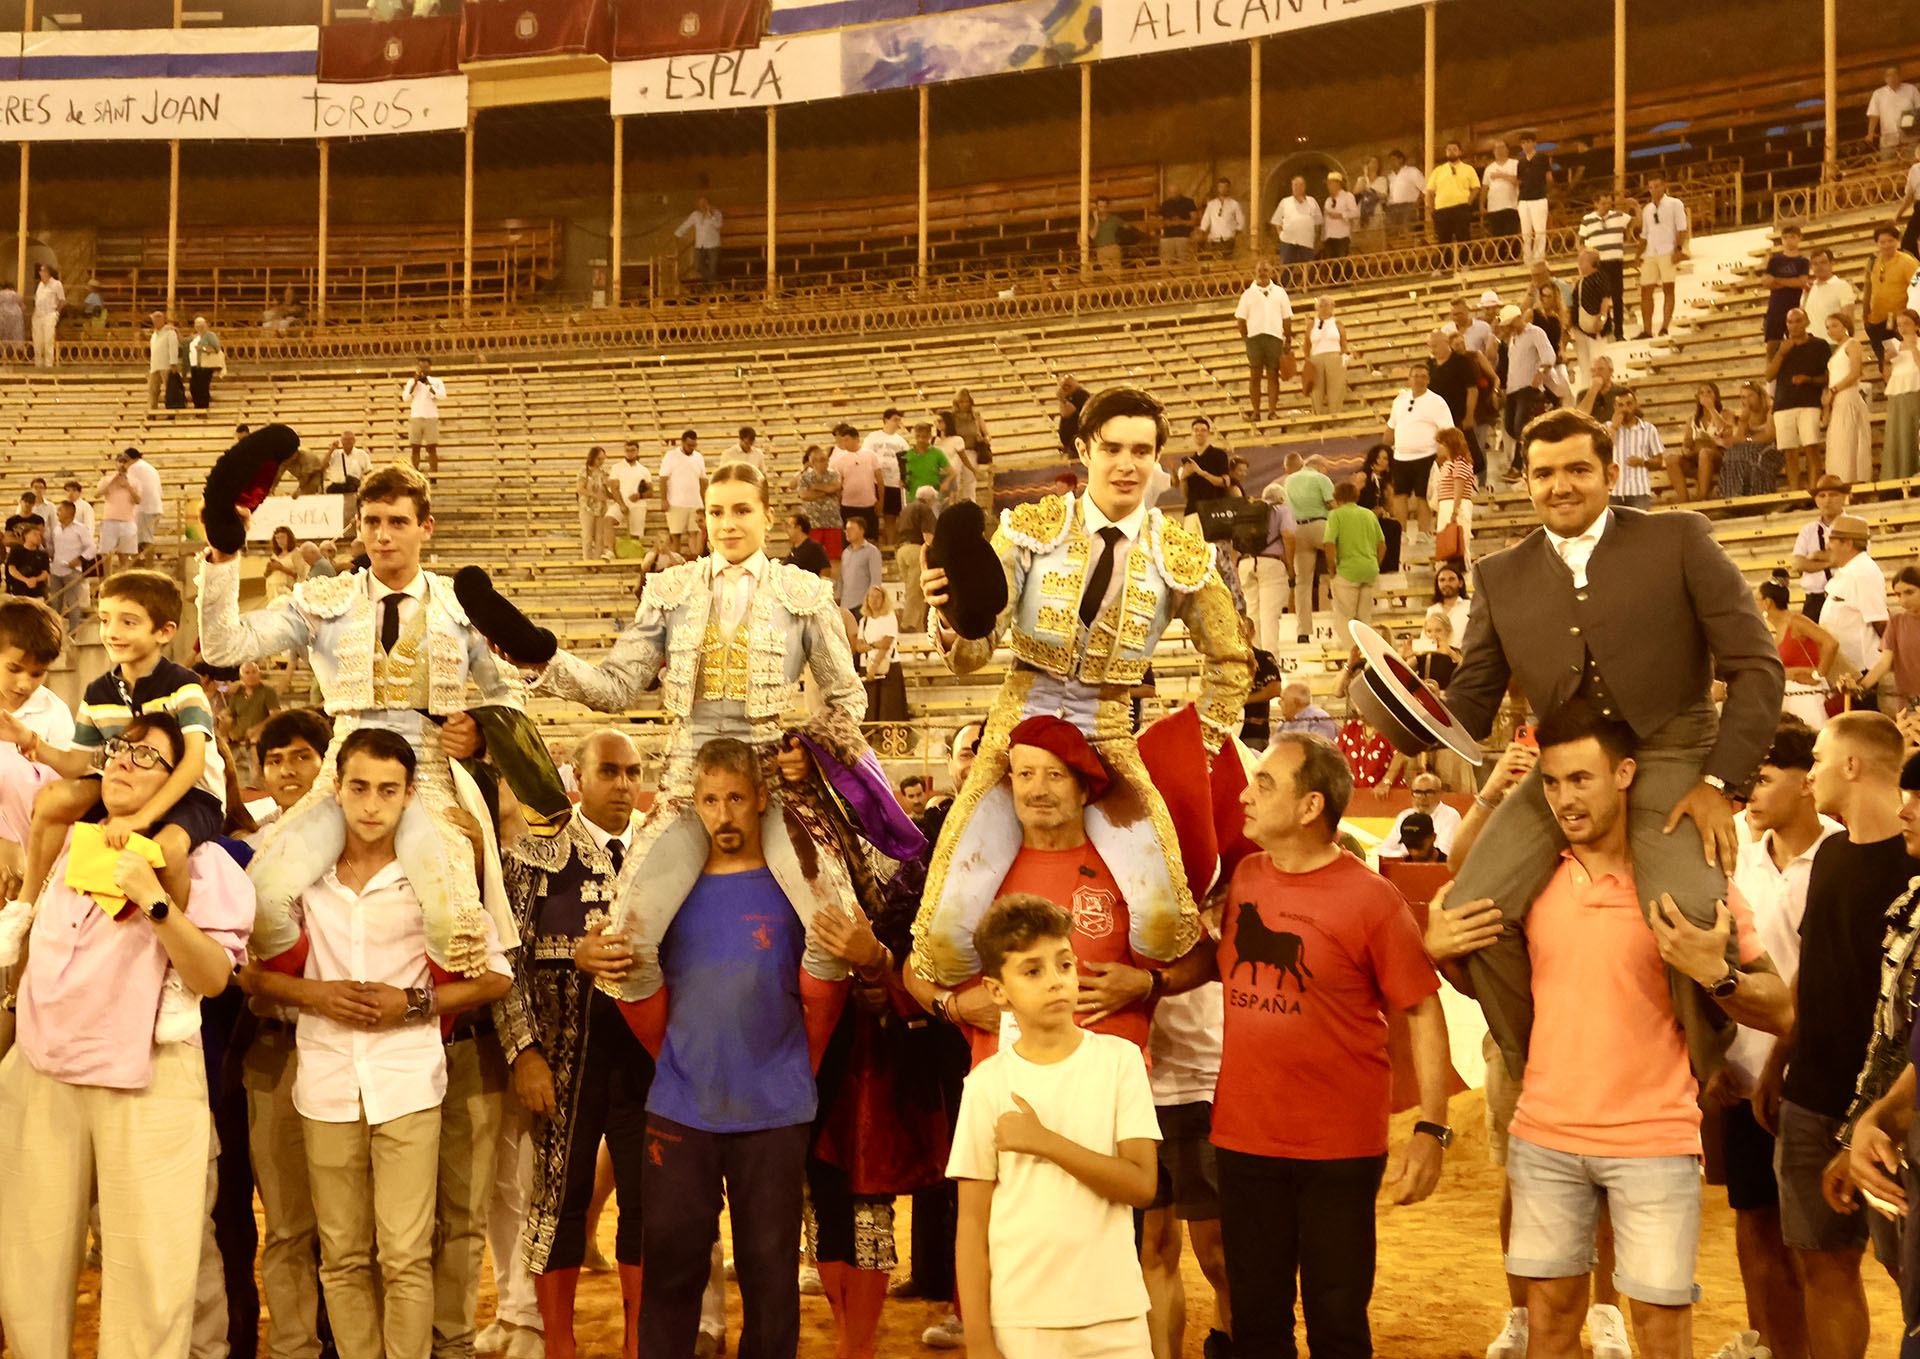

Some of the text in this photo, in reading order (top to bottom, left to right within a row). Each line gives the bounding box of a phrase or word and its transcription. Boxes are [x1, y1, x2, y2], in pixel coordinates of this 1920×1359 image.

[666, 41, 784, 101] ESPLÁ
[66, 99, 86, 126] de
[141, 89, 220, 125] JOAN
[1230, 988, 1302, 1015] ESPAÑA
